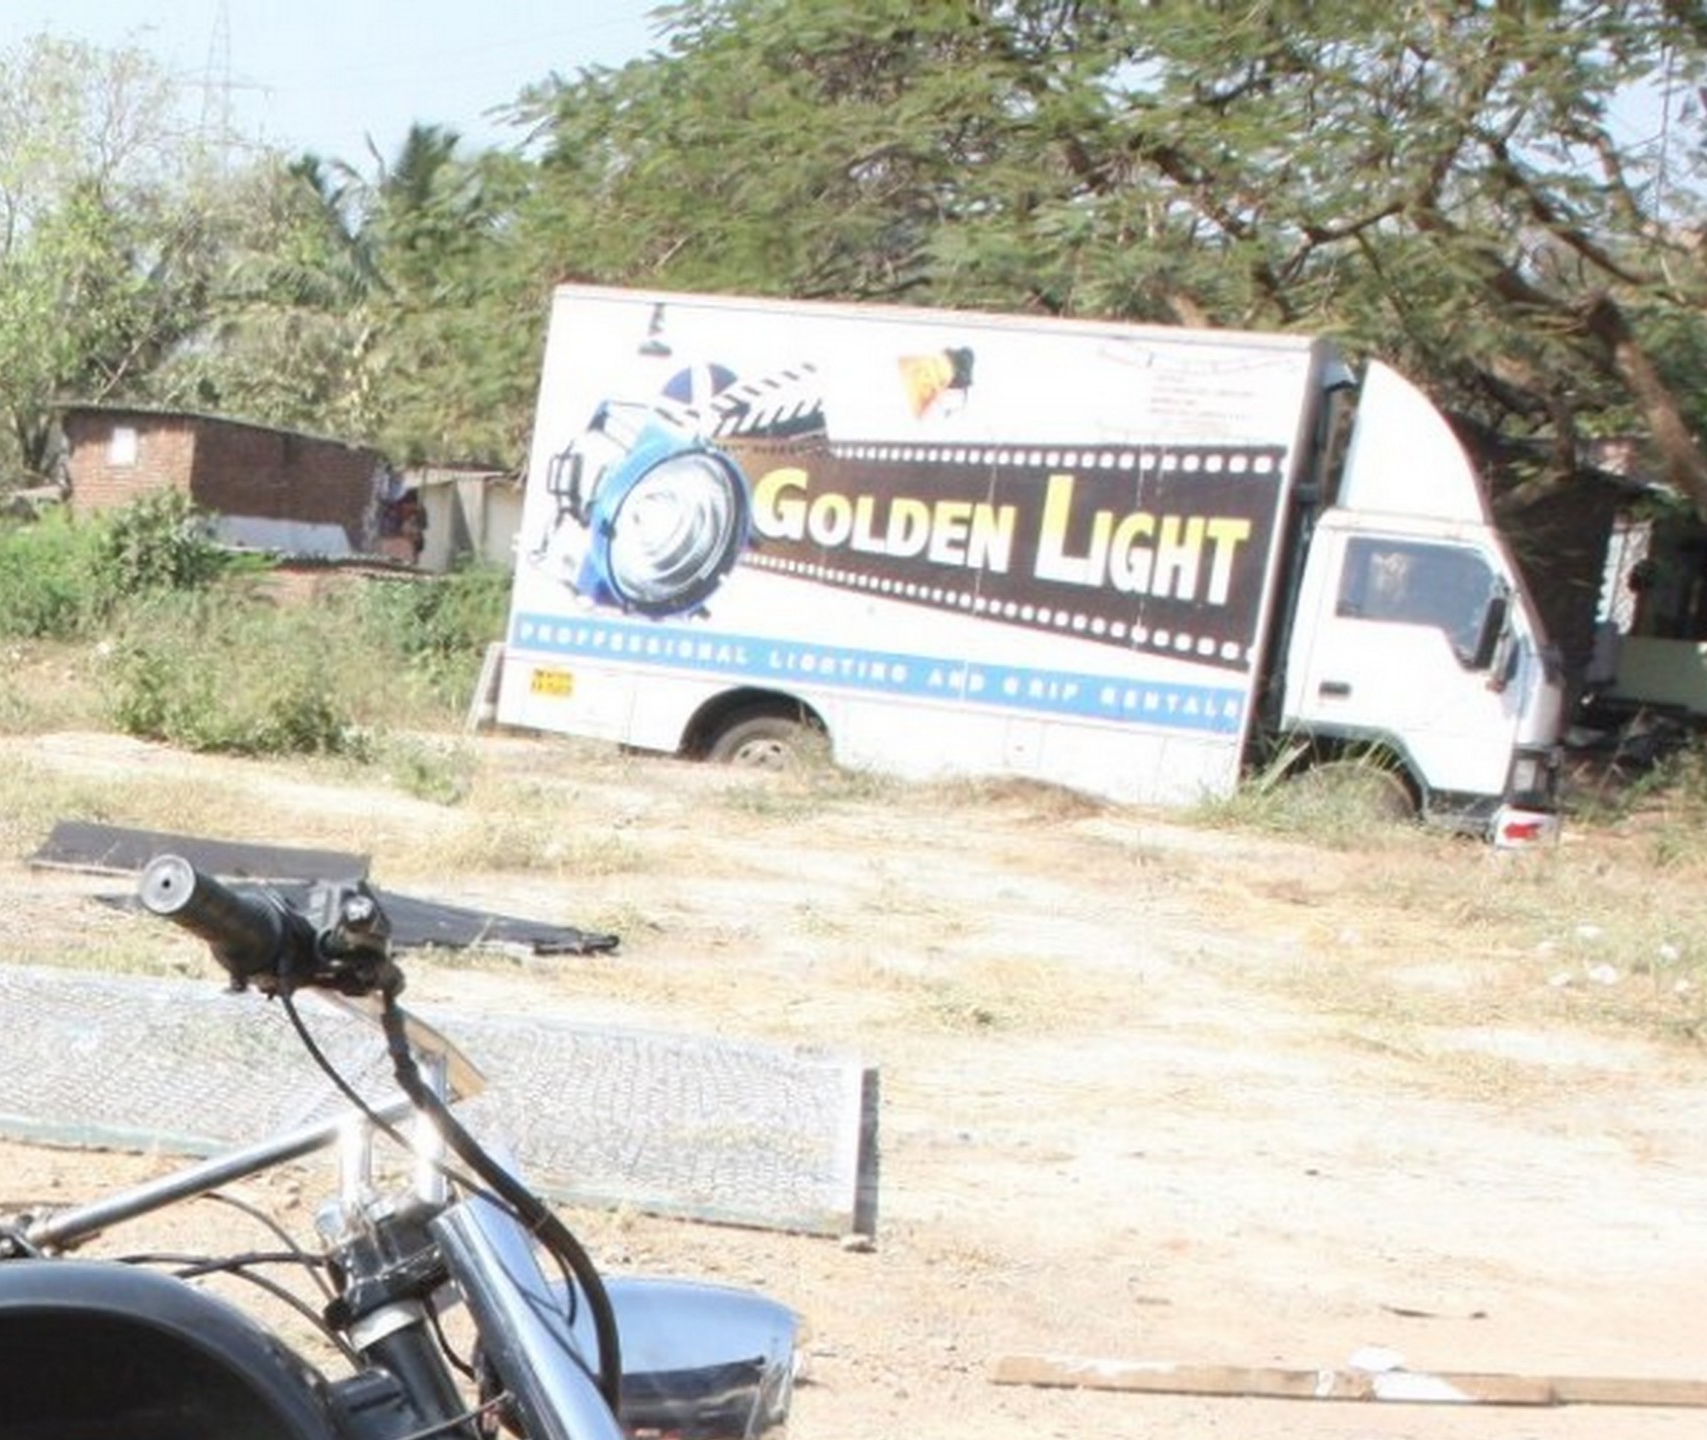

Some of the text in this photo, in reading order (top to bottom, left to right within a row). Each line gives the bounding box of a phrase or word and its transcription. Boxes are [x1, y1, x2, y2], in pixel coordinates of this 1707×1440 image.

[752, 467, 1251, 605] GOLDEN LIGHT
[768, 651, 908, 682] LIGHTING
[926, 668, 985, 692] AND
[1003, 677, 1080, 700] GRIP
[1100, 686, 1239, 718] RENTALS
